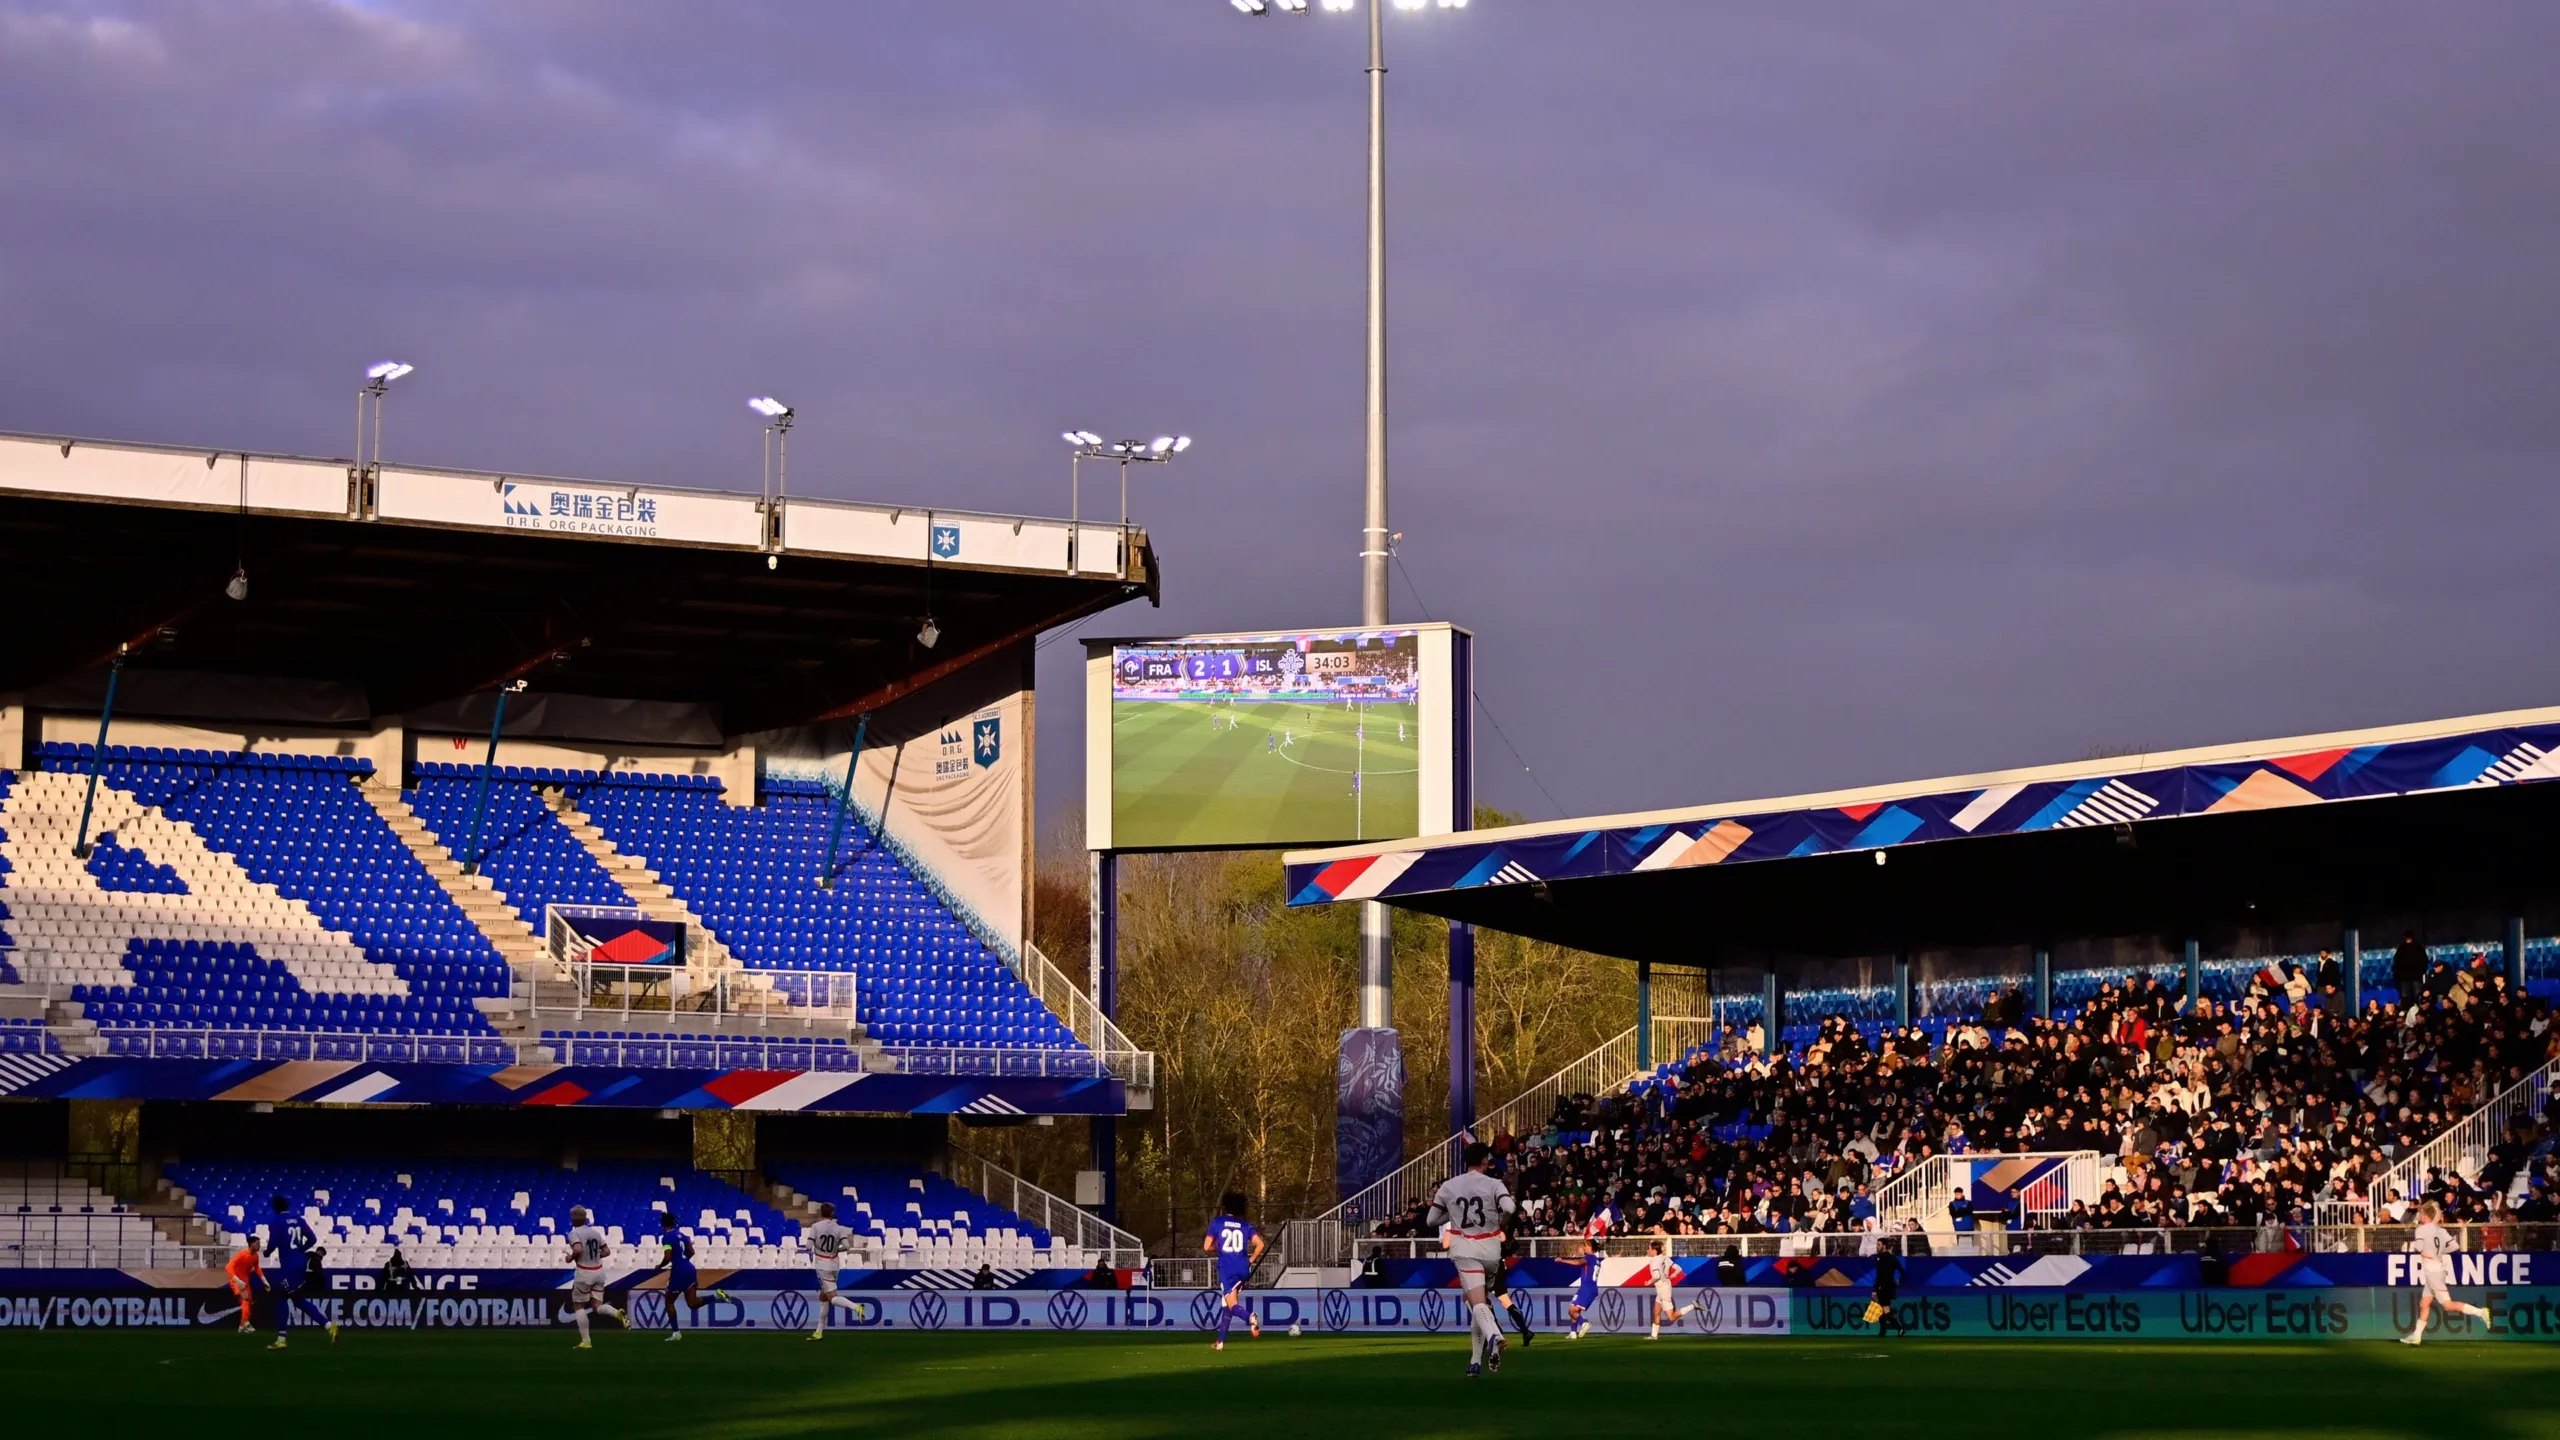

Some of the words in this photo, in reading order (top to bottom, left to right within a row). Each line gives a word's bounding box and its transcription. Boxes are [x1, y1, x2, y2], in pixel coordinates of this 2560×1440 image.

[550, 491, 657, 523] 奥瑞金包装
[550, 520, 576, 531] ORG
[581, 522, 657, 537] PACKAGING
[1149, 664, 1172, 676] FRA
[1195, 660, 1205, 676] 2
[1222, 660, 1232, 675] 1
[1256, 659, 1273, 672] ISL
[1314, 656, 1350, 669] 34:03
[1456, 1196, 1486, 1229] 23
[586, 1238, 599, 1261] 19
[819, 1234, 835, 1254] 20
[1221, 1228, 1244, 1253] 20
[964, 1296, 1031, 1327] ID.
[1106, 1296, 1174, 1327] ID.
[1363, 1295, 1409, 1326] ID.
[1735, 1294, 1784, 1328] ID.
[1987, 1293, 2059, 1331] Uber
[2066, 1293, 2141, 1332] Eats
[2180, 1293, 2258, 1333] Uber
[2266, 1293, 2349, 1333] Eats
